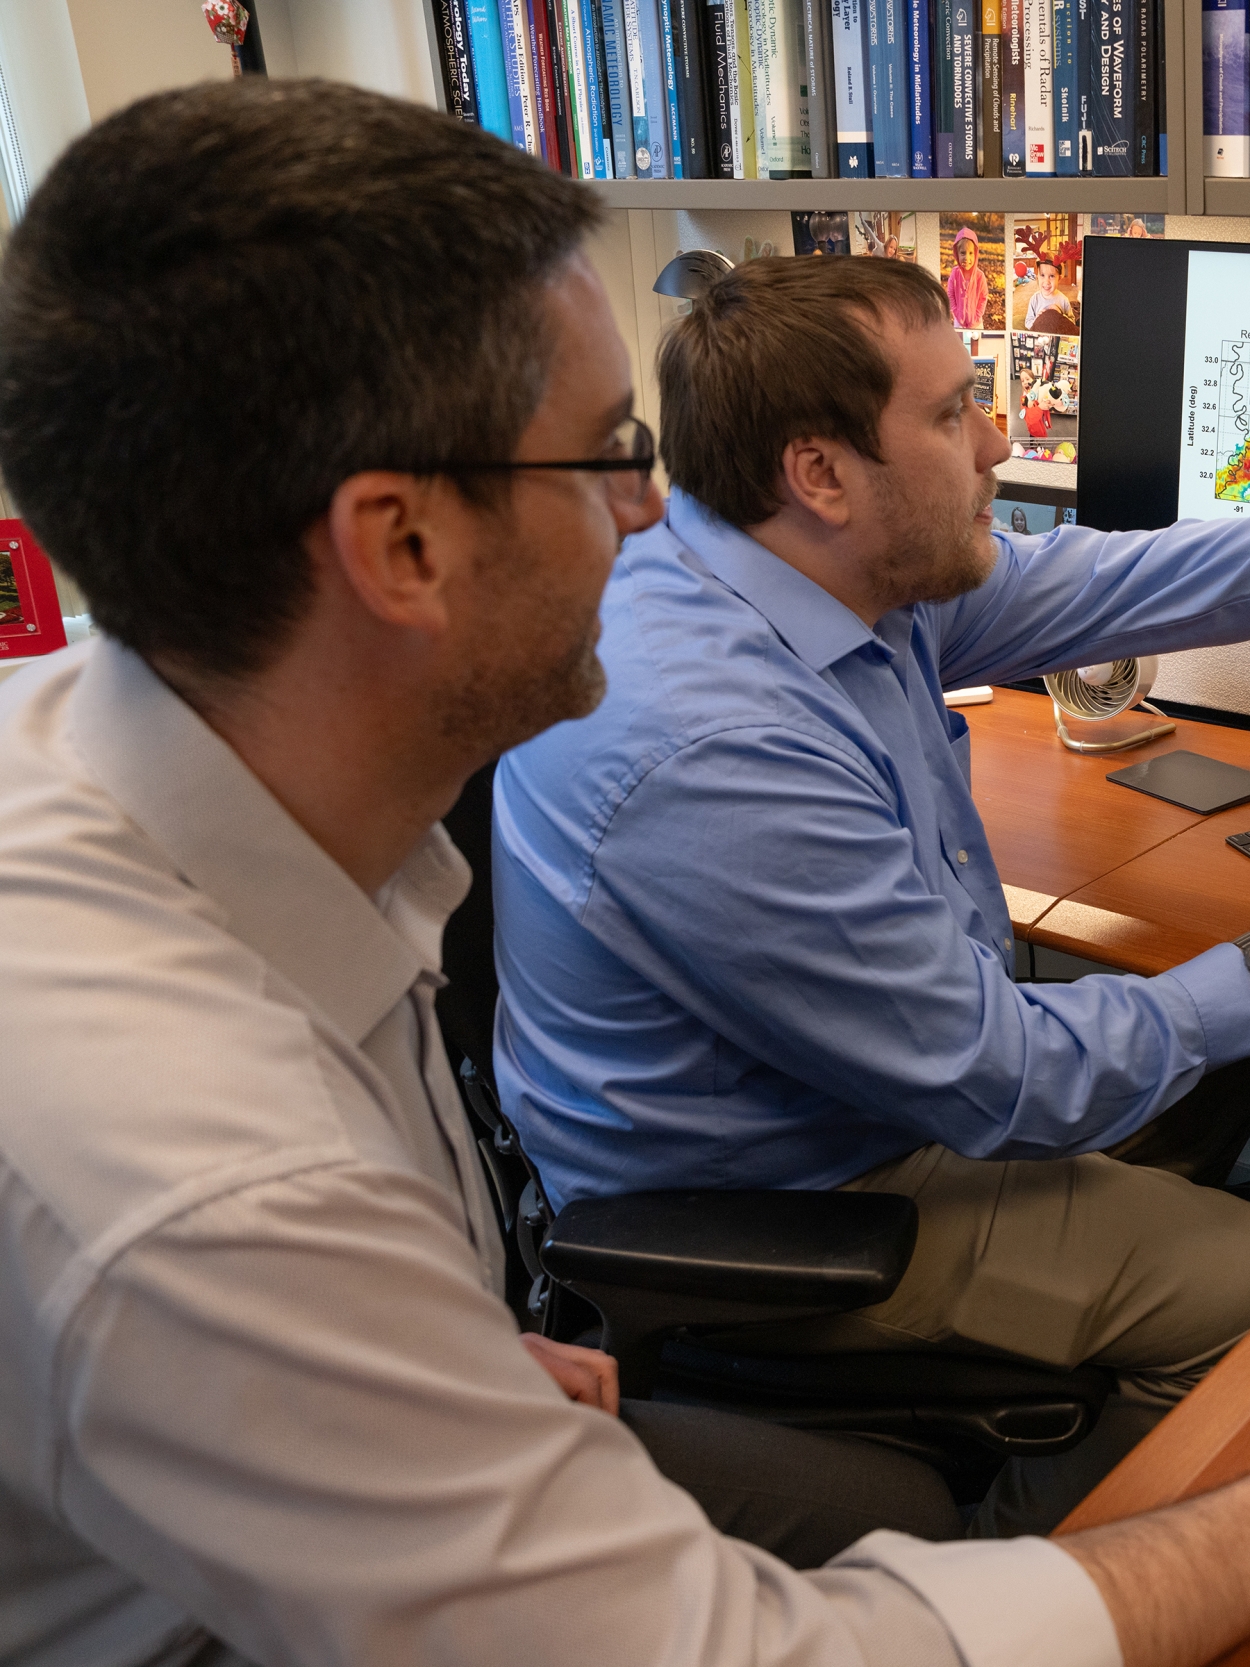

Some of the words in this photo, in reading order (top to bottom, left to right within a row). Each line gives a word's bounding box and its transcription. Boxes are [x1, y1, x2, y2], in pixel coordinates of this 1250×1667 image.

[442, 1, 459, 86] ATMOSPHERIC
[714, 12, 726, 46] Fluid
[954, 35, 962, 54] AND
[1101, 12, 1109, 40] AND
[1113, 17, 1122, 35] OF
[518, 54, 526, 85] Edition
[665, 34, 674, 91] Meteorology
[964, 35, 972, 67] SEVERE
[460, 54, 470, 101] Today
[585, 28, 595, 84] Atmospheric
[590, 86, 598, 128] Radiation
[606, 40, 623, 127] METEOROLOGY
[954, 56, 962, 108] TORNADOES
[992, 60, 1000, 89] Sensing
[1040, 68, 1051, 107] Radar
[1101, 45, 1111, 96] DESIGN
[1113, 40, 1124, 118] WAVEFORM
[716, 50, 729, 130] Mechanics
[964, 69, 973, 123] CONVECTIVE
[1061, 87, 1069, 122] Skolnik
[536, 98, 544, 132] Handbook
[965, 124, 973, 160] STORMS
[1187, 385, 1198, 406] (deg)
[1187, 408, 1197, 446] Latitude
